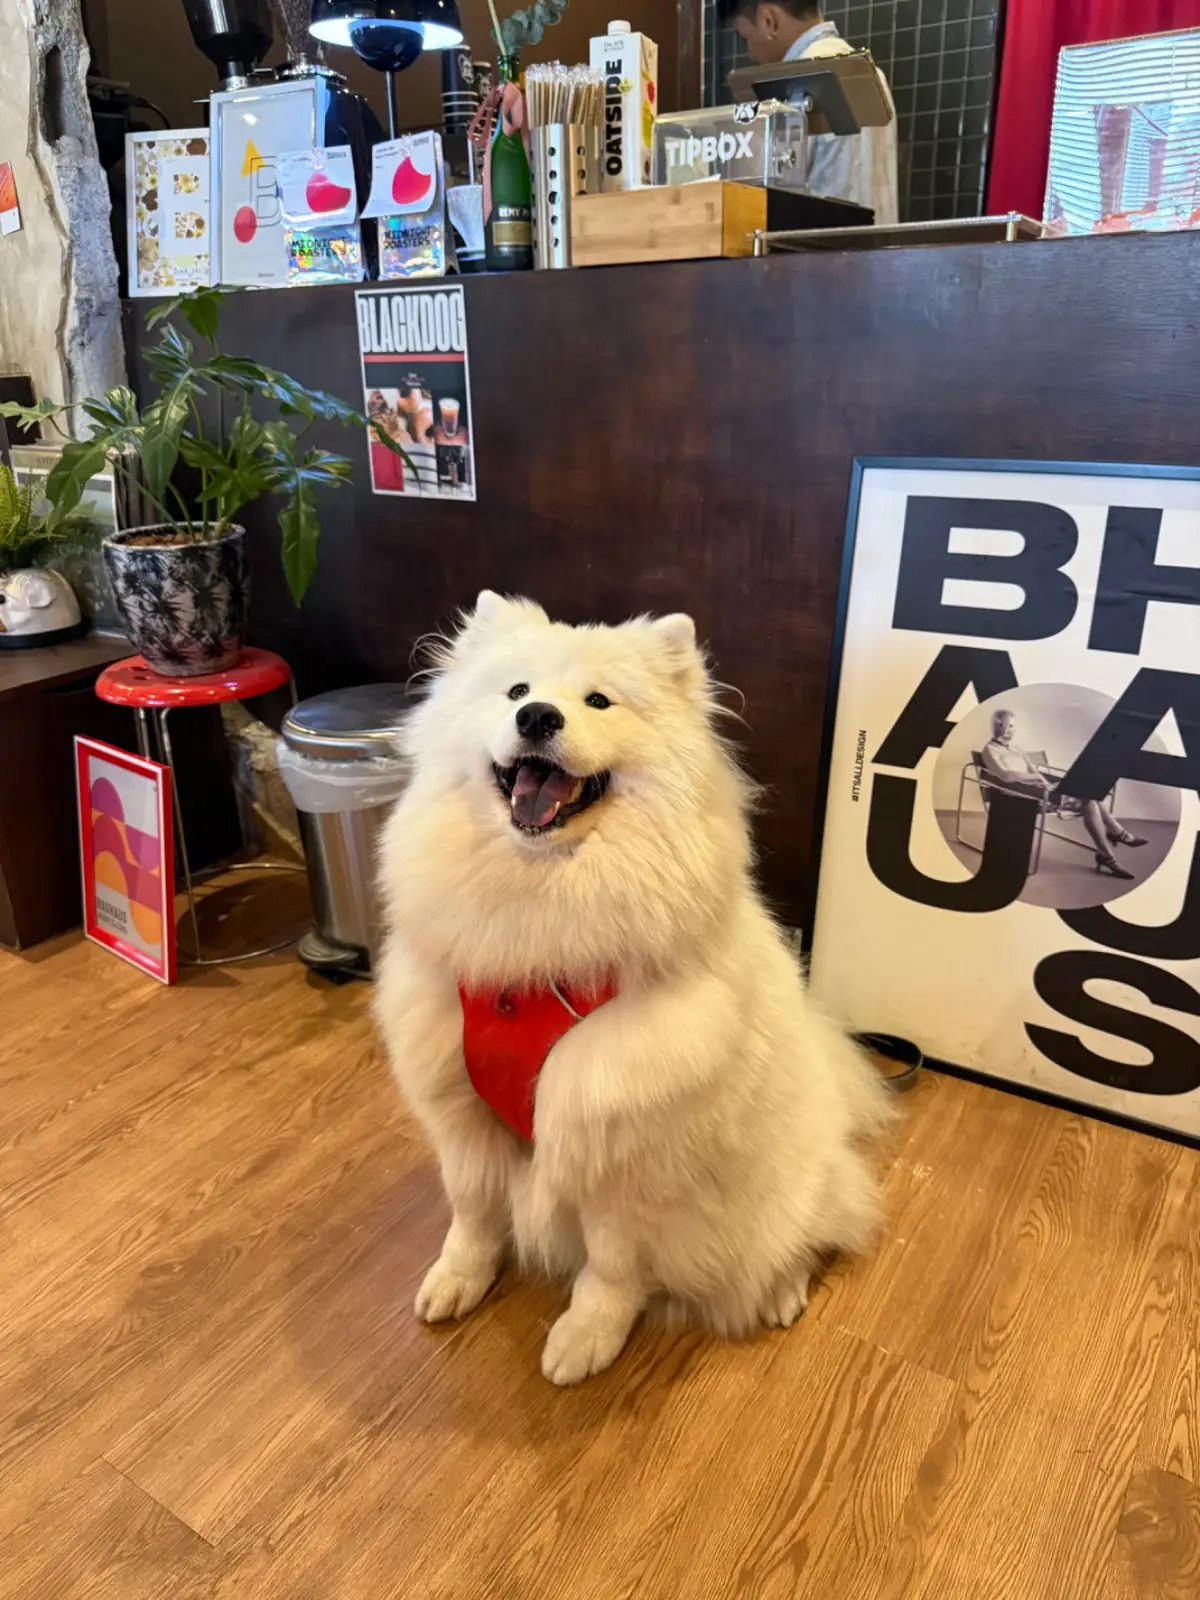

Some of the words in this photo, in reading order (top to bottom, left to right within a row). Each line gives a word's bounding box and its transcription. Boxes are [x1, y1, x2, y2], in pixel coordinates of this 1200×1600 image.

[605, 58, 622, 176] OATSIDE
[664, 130, 754, 167] TIPBOX
[383, 236, 431, 249] ROASTERS
[384, 225, 431, 239] MIDNIGHT
[357, 292, 465, 352] BLACKDOG
[852, 729, 867, 802] #ITSALLDESIGN
